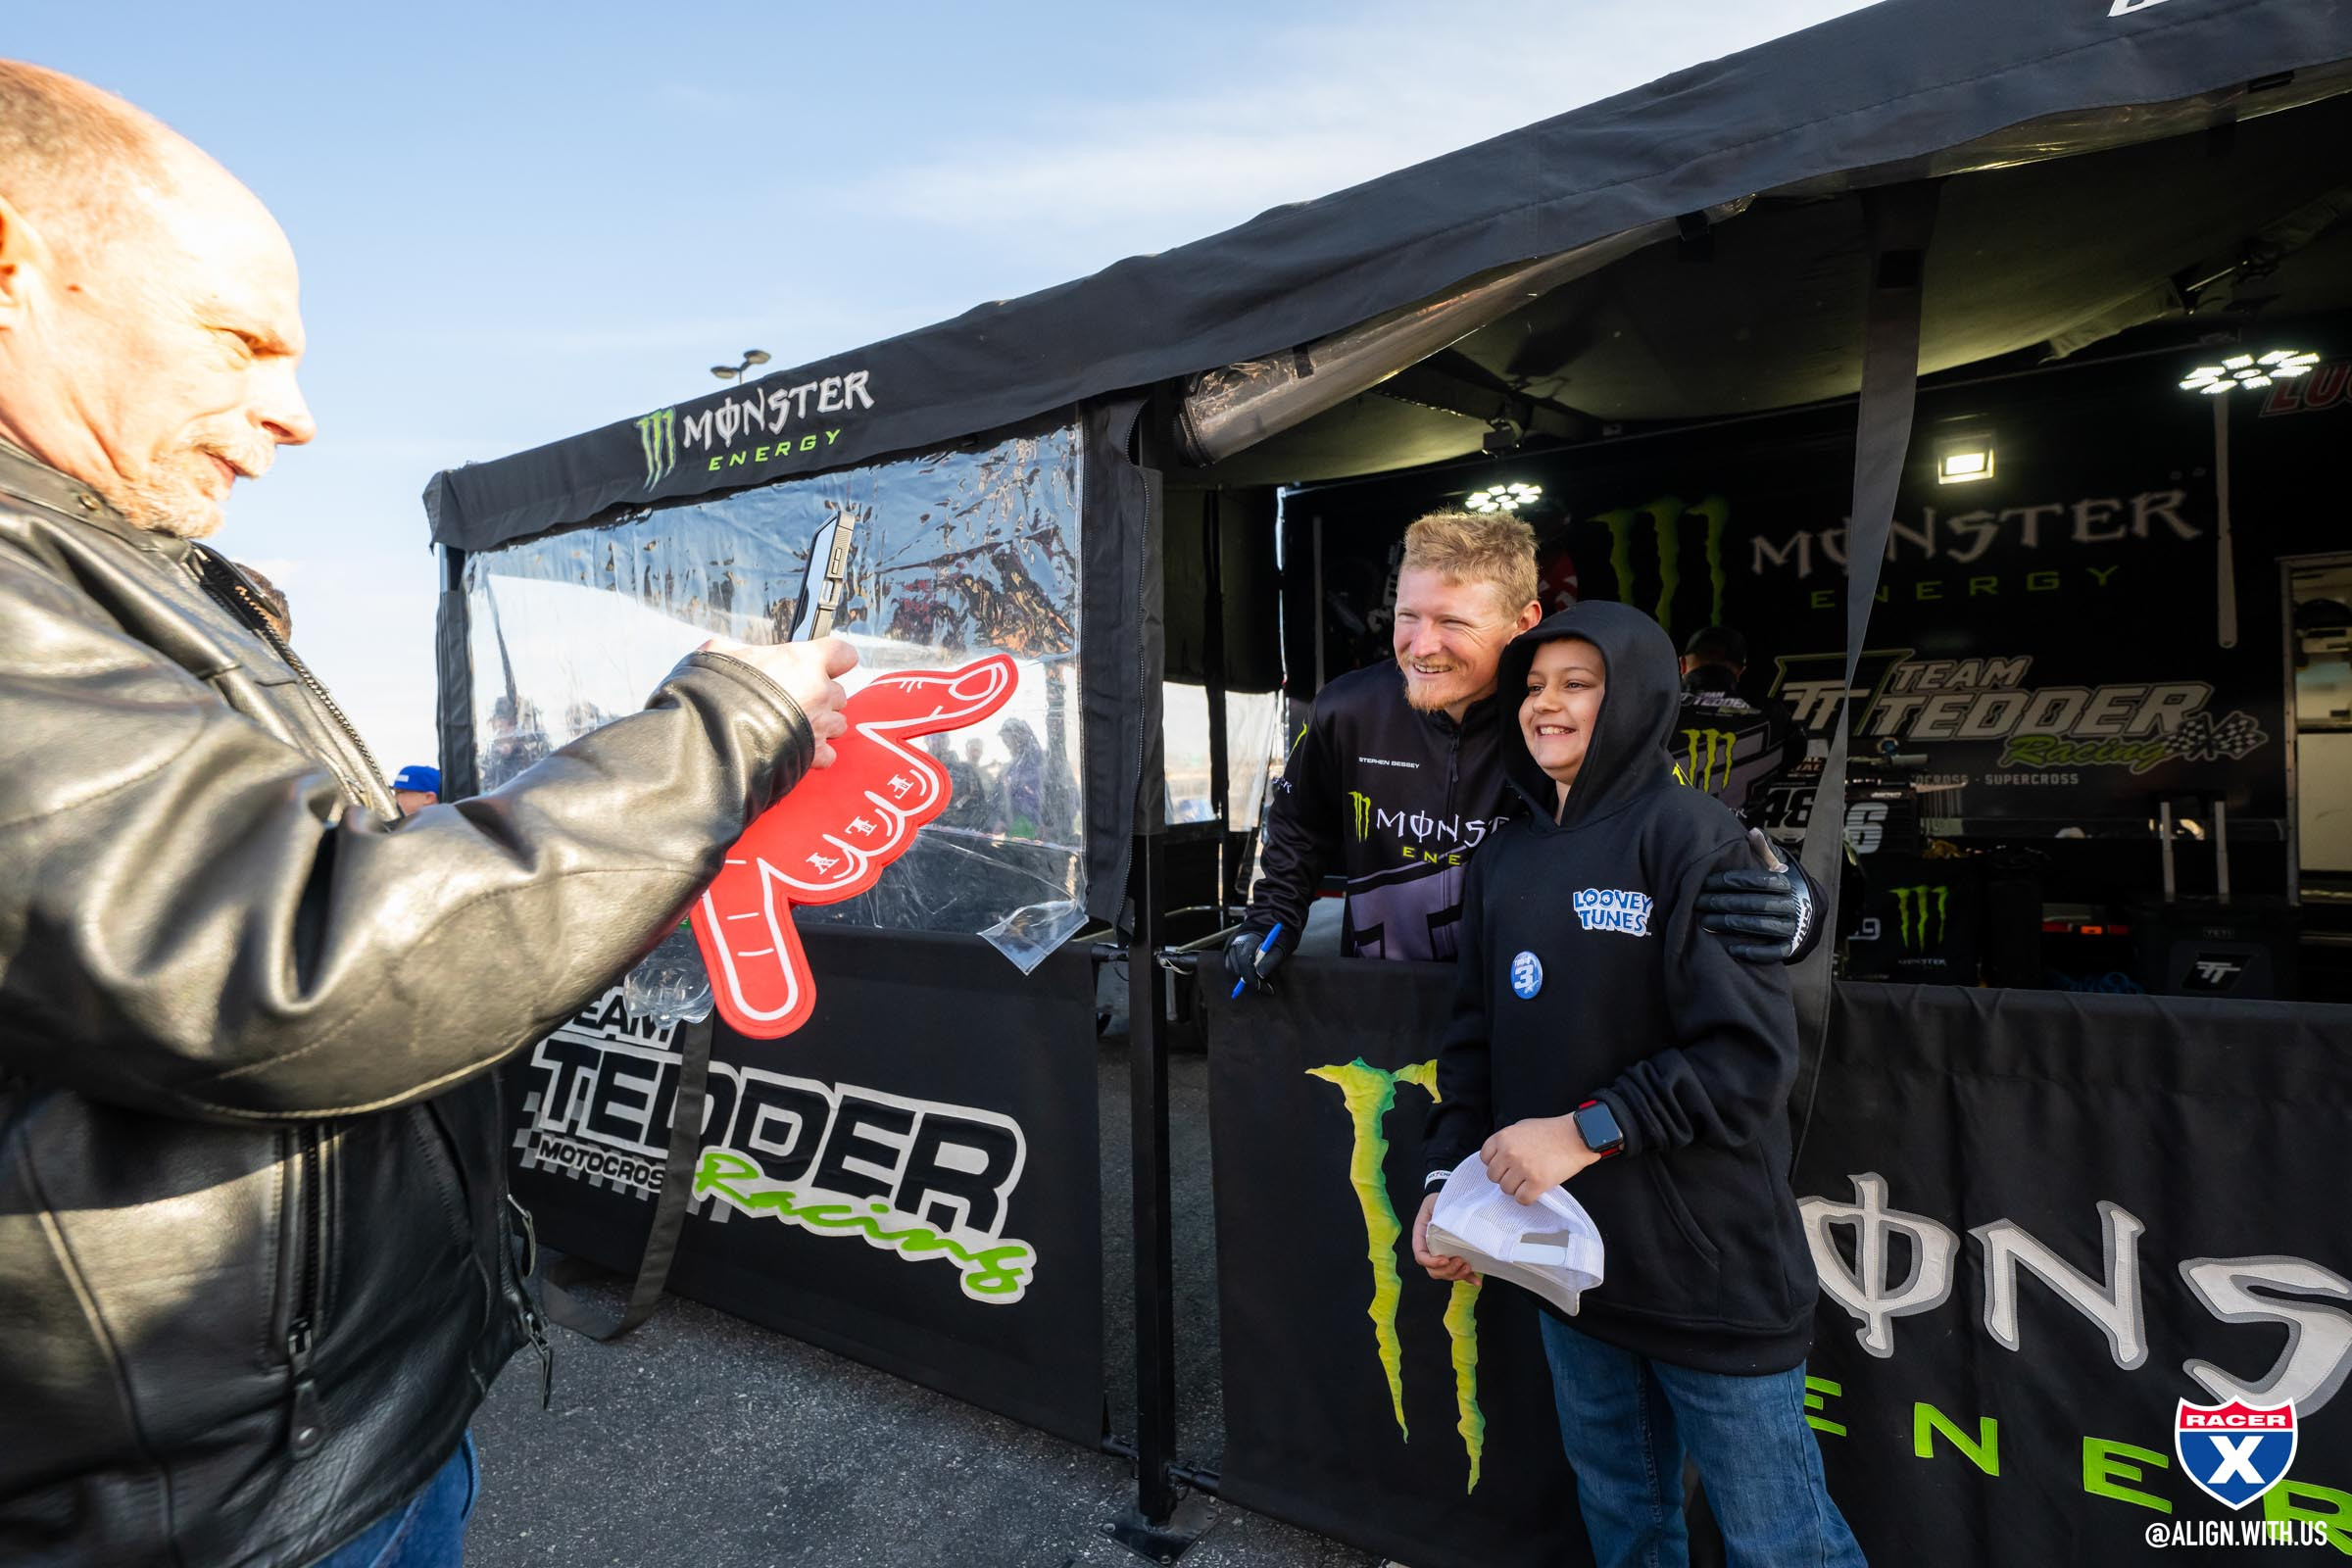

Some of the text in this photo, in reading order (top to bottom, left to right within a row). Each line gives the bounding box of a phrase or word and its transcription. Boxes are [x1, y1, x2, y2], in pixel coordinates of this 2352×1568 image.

[682, 369, 875, 450] MONSTER
[2259, 361, 2352, 417] LU
[708, 428, 841, 471] ENERGY
[1894, 657, 2031, 691] TEAM
[1869, 683, 2212, 739] TEDDER
[1358, 757, 1390, 765] STEPHEN
[1984, 772, 2079, 785] SUPERCROSS
[2007, 734, 2169, 771] Racing
[1376, 808, 1510, 848] MONST
[1844, 802, 1889, 855] 6
[1402, 846, 1462, 865] ENE
[1579, 909, 1647, 935] TUNES
[570, 989, 671, 1045] EAM
[538, 1036, 1022, 1237] TEDDER
[539, 1138, 666, 1191] MOTOCROS
[695, 1151, 1029, 1296] Racing
[1794, 1171, 2352, 1420] ONS
[1804, 1375, 2352, 1556] ENER
